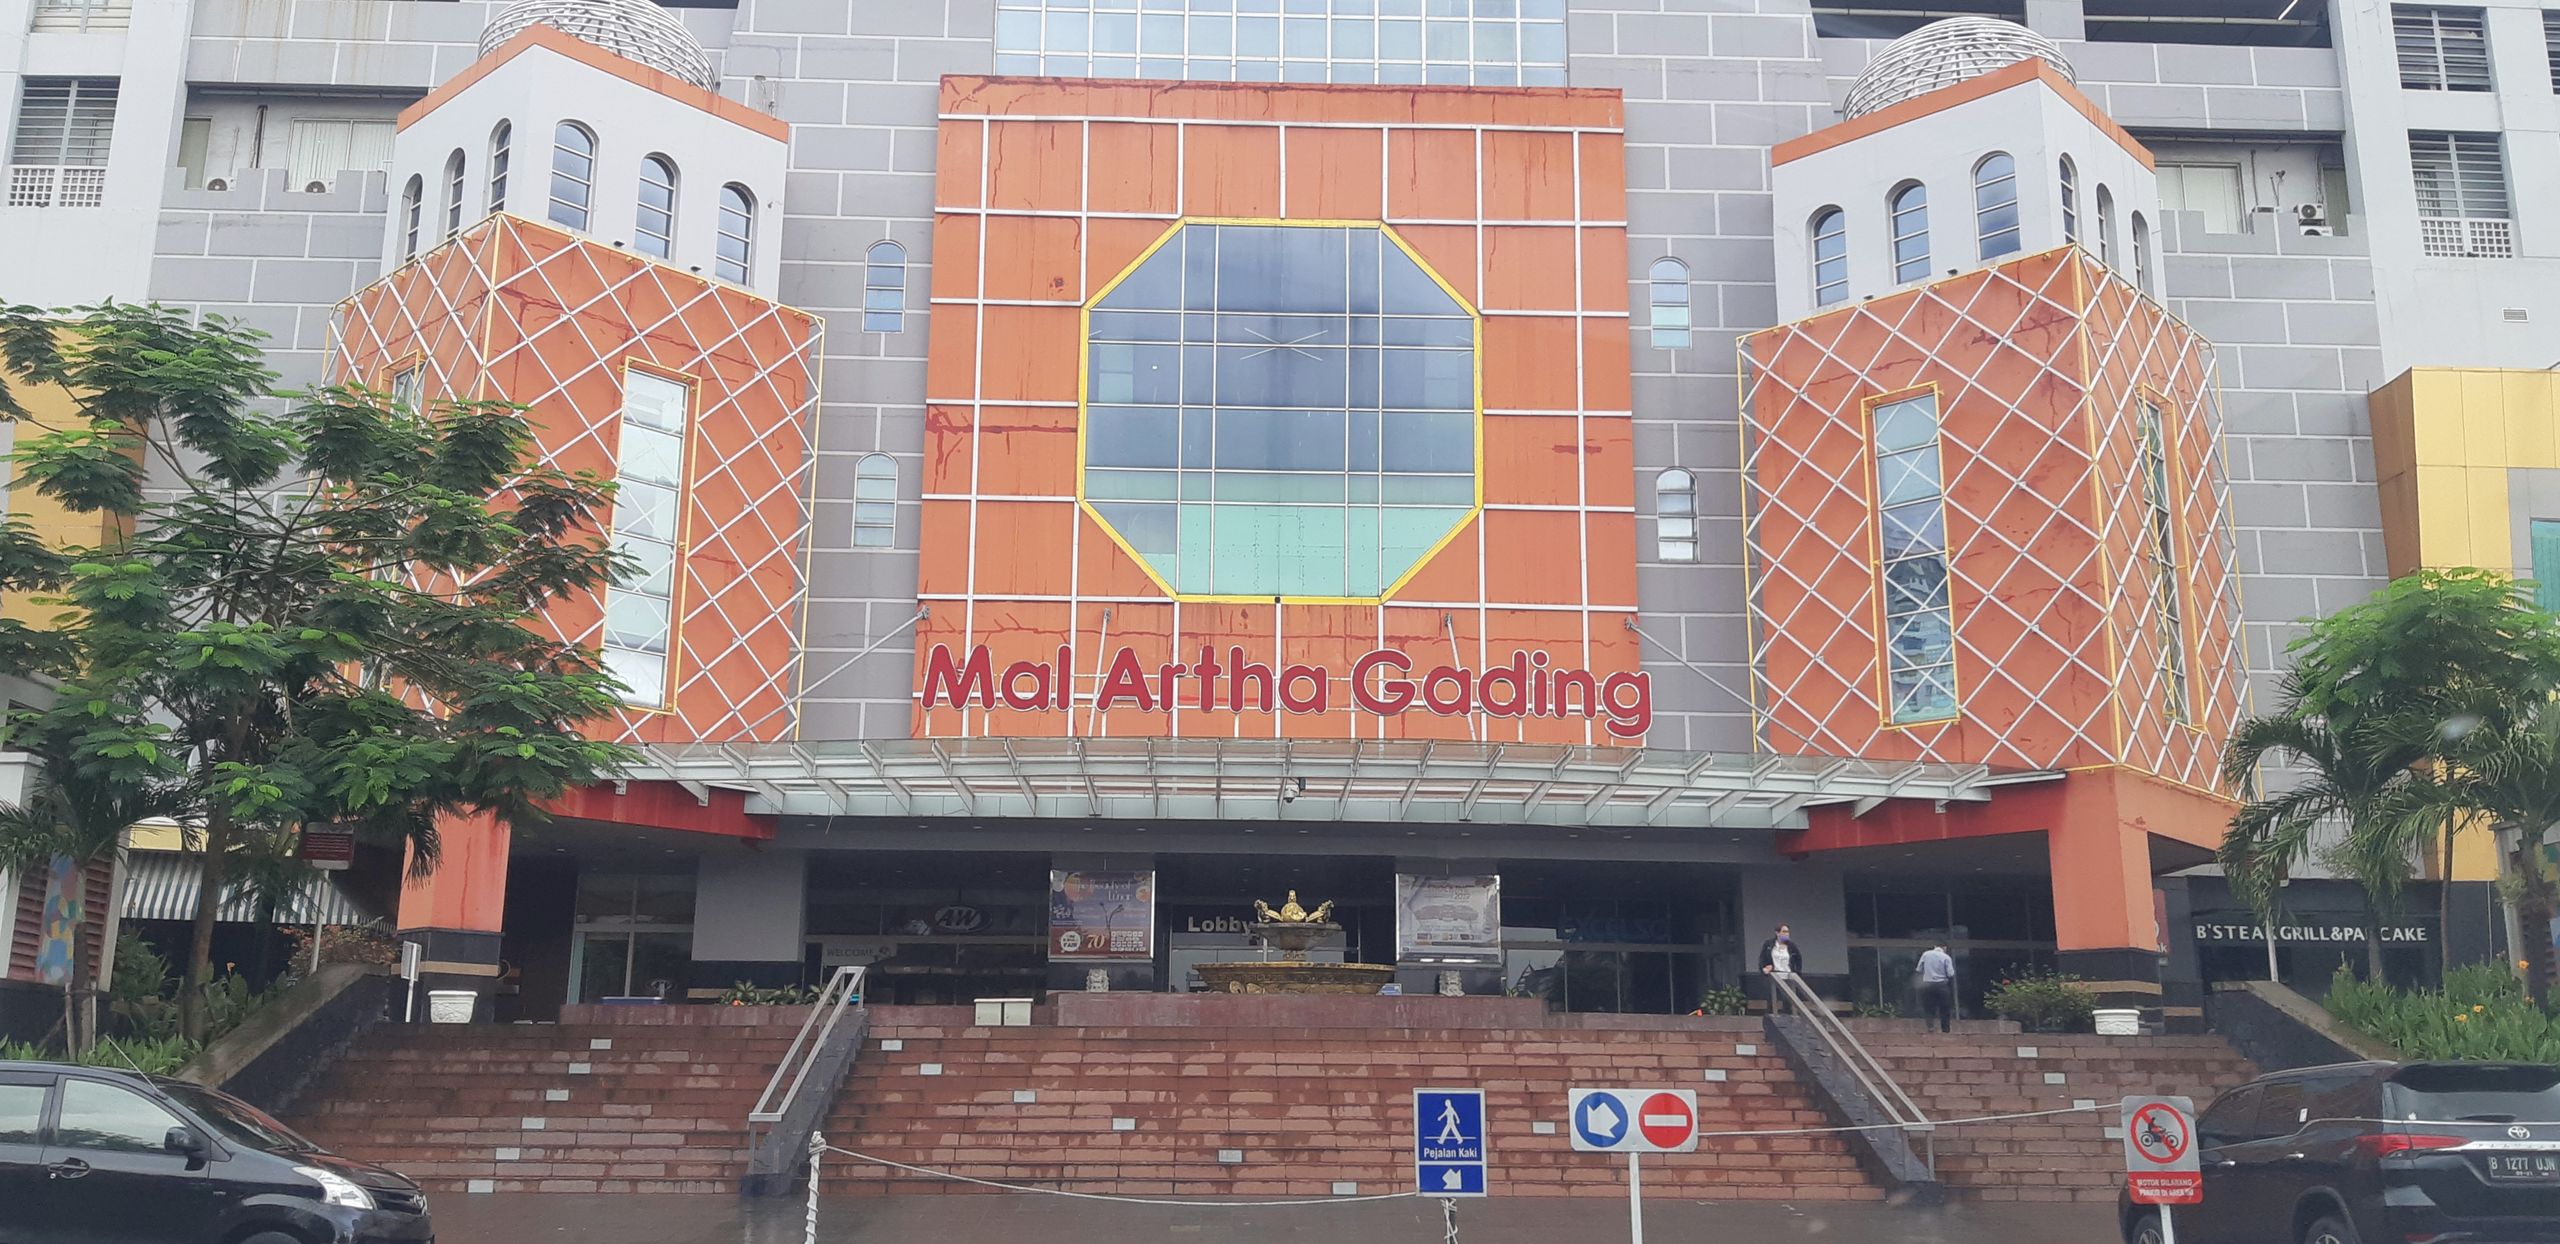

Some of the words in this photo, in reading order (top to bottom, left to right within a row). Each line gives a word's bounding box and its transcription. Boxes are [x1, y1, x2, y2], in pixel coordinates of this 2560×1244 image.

[923, 643, 1074, 712] Mal
[1095, 644, 1330, 716] Artha
[1350, 648, 1654, 738] Gading
[1187, 916, 1253, 937] Lobby
[2280, 925, 2428, 942] GRILL&PACAKE
[1086, 934, 1105, 949] 70
[1424, 1147, 1457, 1160] Pejalan
[1458, 1147, 1478, 1158] Kaki
[2490, 1156, 2498, 1170] B
[2505, 1157, 2529, 1170] 1277
[2536, 1157, 2556, 1171] UJN
